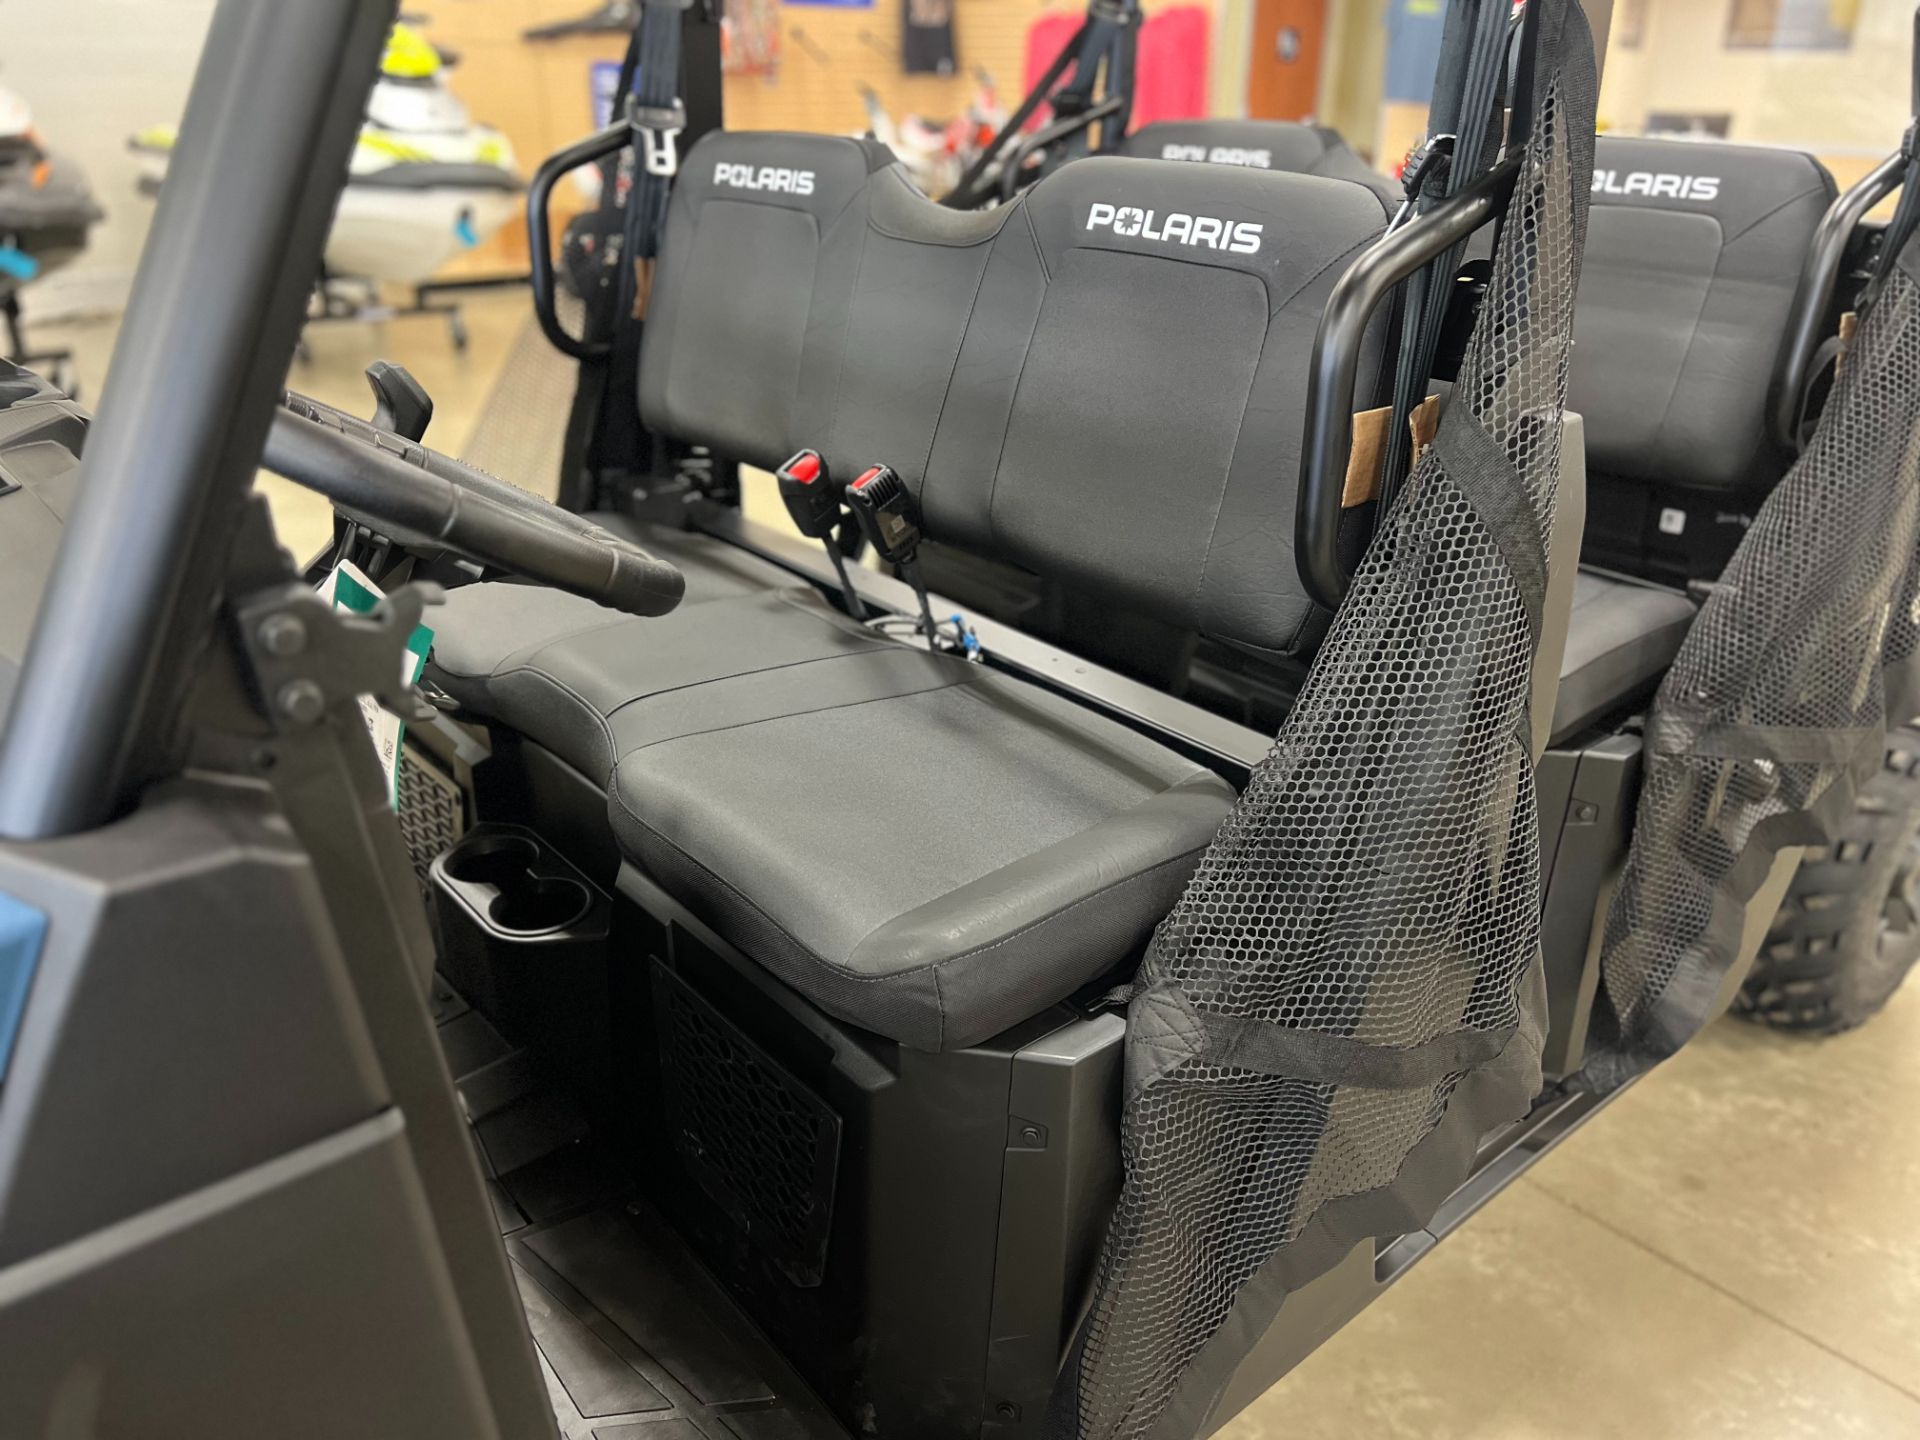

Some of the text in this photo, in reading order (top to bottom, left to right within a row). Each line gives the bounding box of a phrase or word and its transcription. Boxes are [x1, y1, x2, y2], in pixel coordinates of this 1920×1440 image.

[713, 162, 815, 195] POLARIS
[1590, 169, 1720, 201] OLARIS
[1086, 203, 1263, 254] POLARIS
